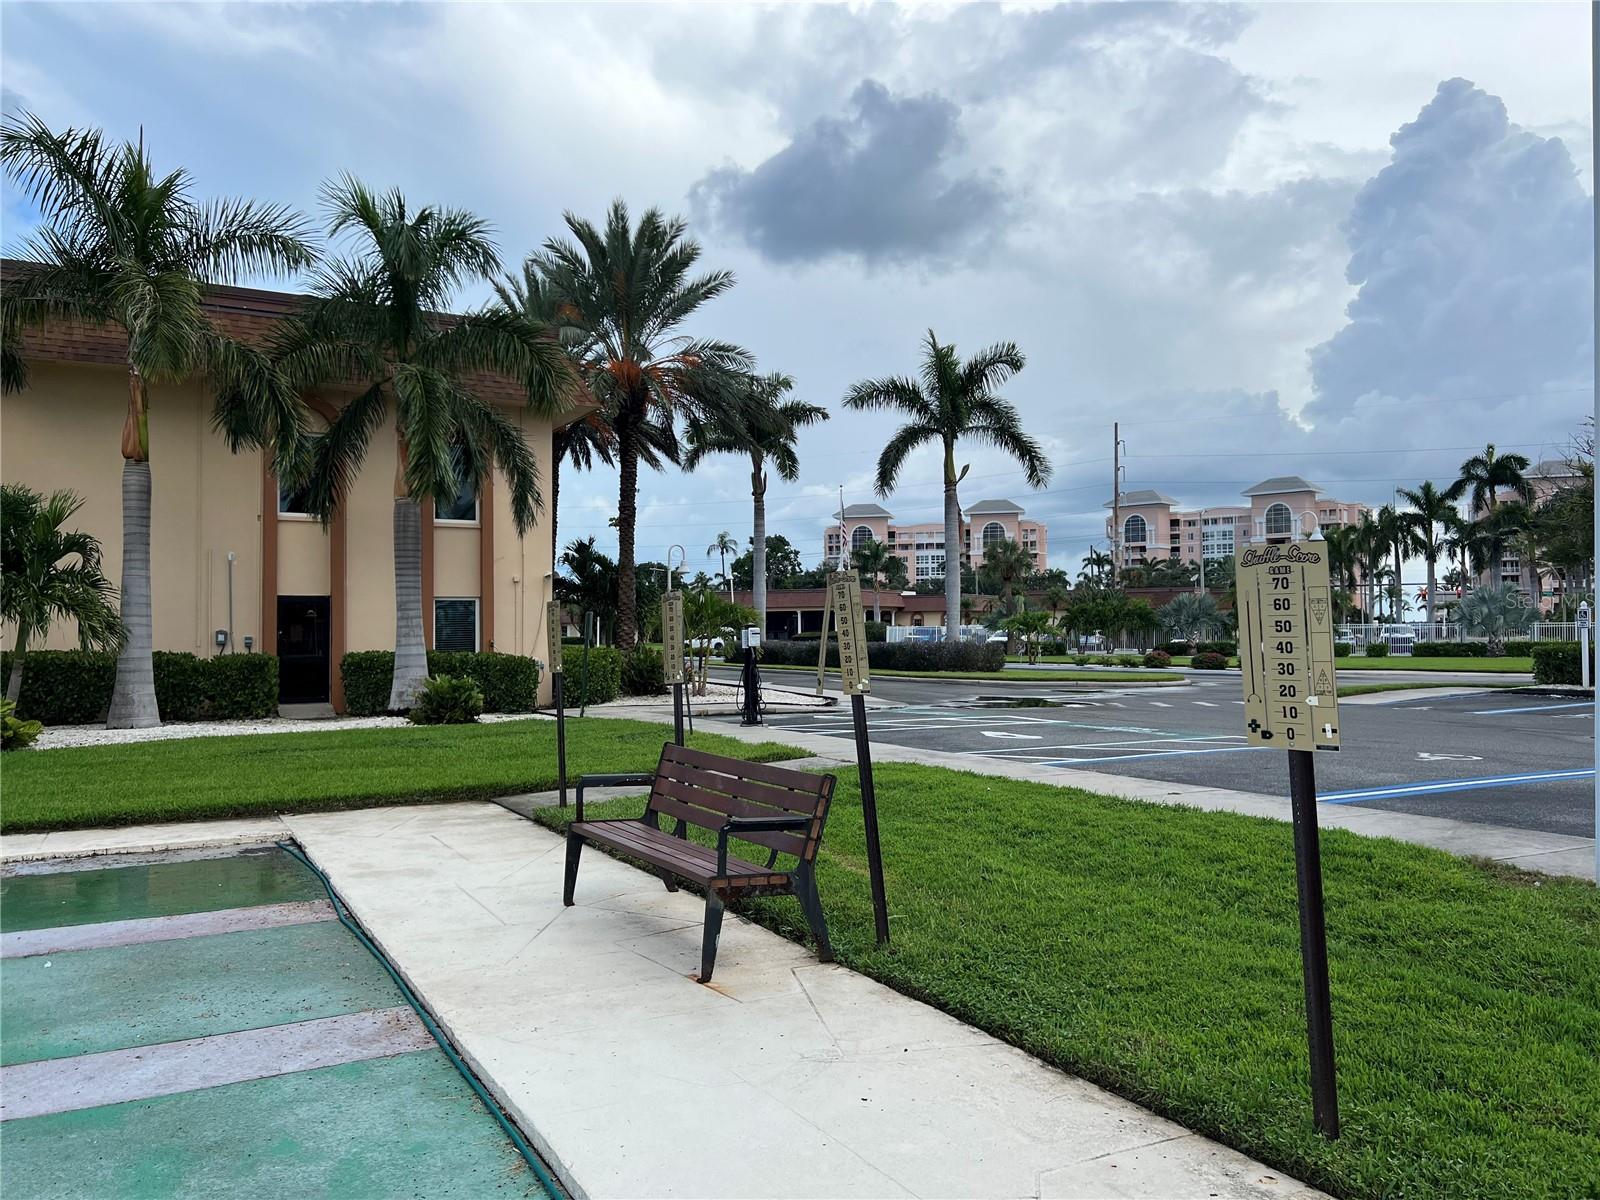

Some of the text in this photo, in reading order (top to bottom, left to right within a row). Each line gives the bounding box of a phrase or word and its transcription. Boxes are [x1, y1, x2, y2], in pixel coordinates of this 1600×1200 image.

[1268, 565, 1291, 575] GAME
[1272, 577, 1289, 590] 70
[838, 591, 845, 599] 70
[839, 603, 847, 612] 60
[1273, 598, 1291, 611] 60
[841, 616, 848, 625] 50
[1275, 620, 1292, 633] 50
[842, 629, 849, 637] 40
[843, 642, 850, 650] 30
[1276, 641, 1293, 654] 40
[844, 655, 852, 664] 20
[846, 668, 854, 677] 10
[1277, 662, 1295, 675] 30
[1279, 685, 1296, 697] 20
[1282, 706, 1298, 719] 10
[1286, 727, 1295, 740] 0
